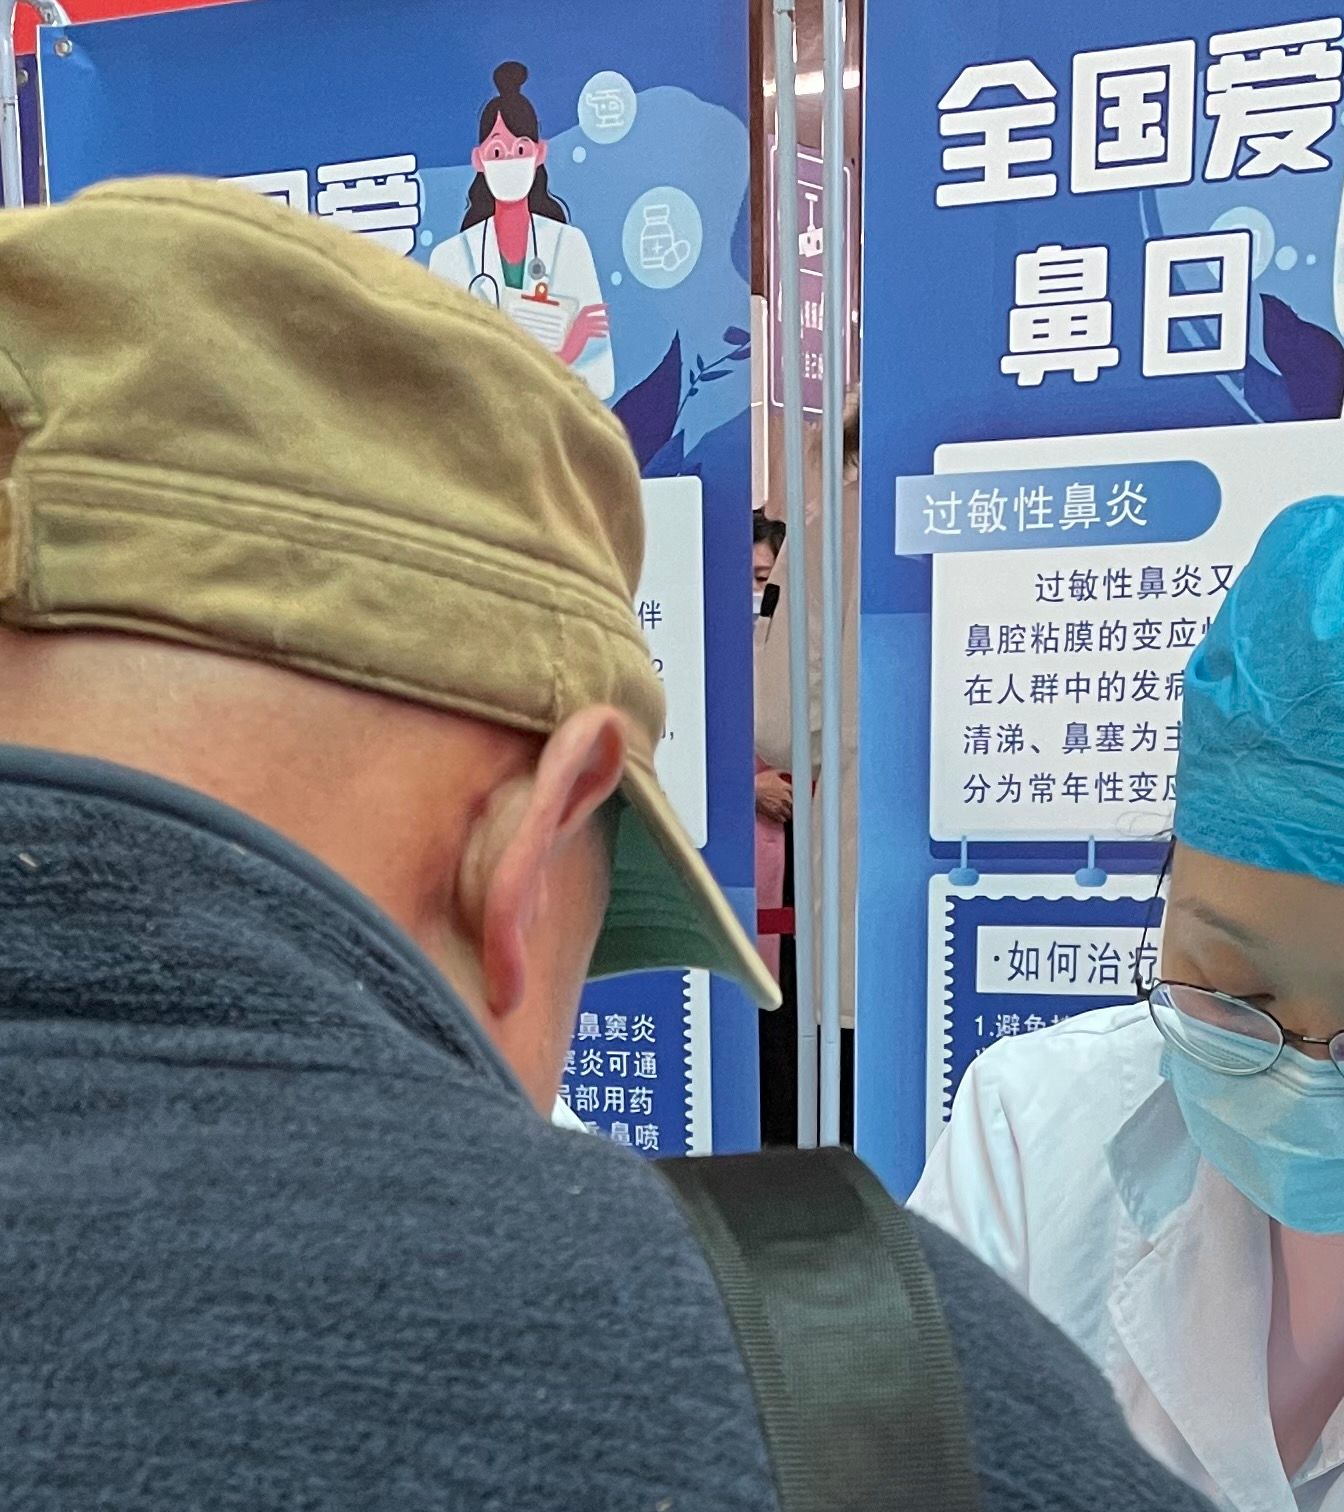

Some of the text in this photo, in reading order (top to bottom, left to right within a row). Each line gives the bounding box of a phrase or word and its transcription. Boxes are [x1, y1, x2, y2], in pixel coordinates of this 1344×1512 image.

[935, 17, 1344, 207] 全国爱
[1001, 230, 1253, 385] 鼻日
[923, 480, 1149, 537] 过敏性鼻炎
[1035, 564, 1230, 604] 过敏性鼻炎又
[570, 1011, 656, 1042] 鼻窦炎
[975, 1013, 1069, 1038] 1.避免
